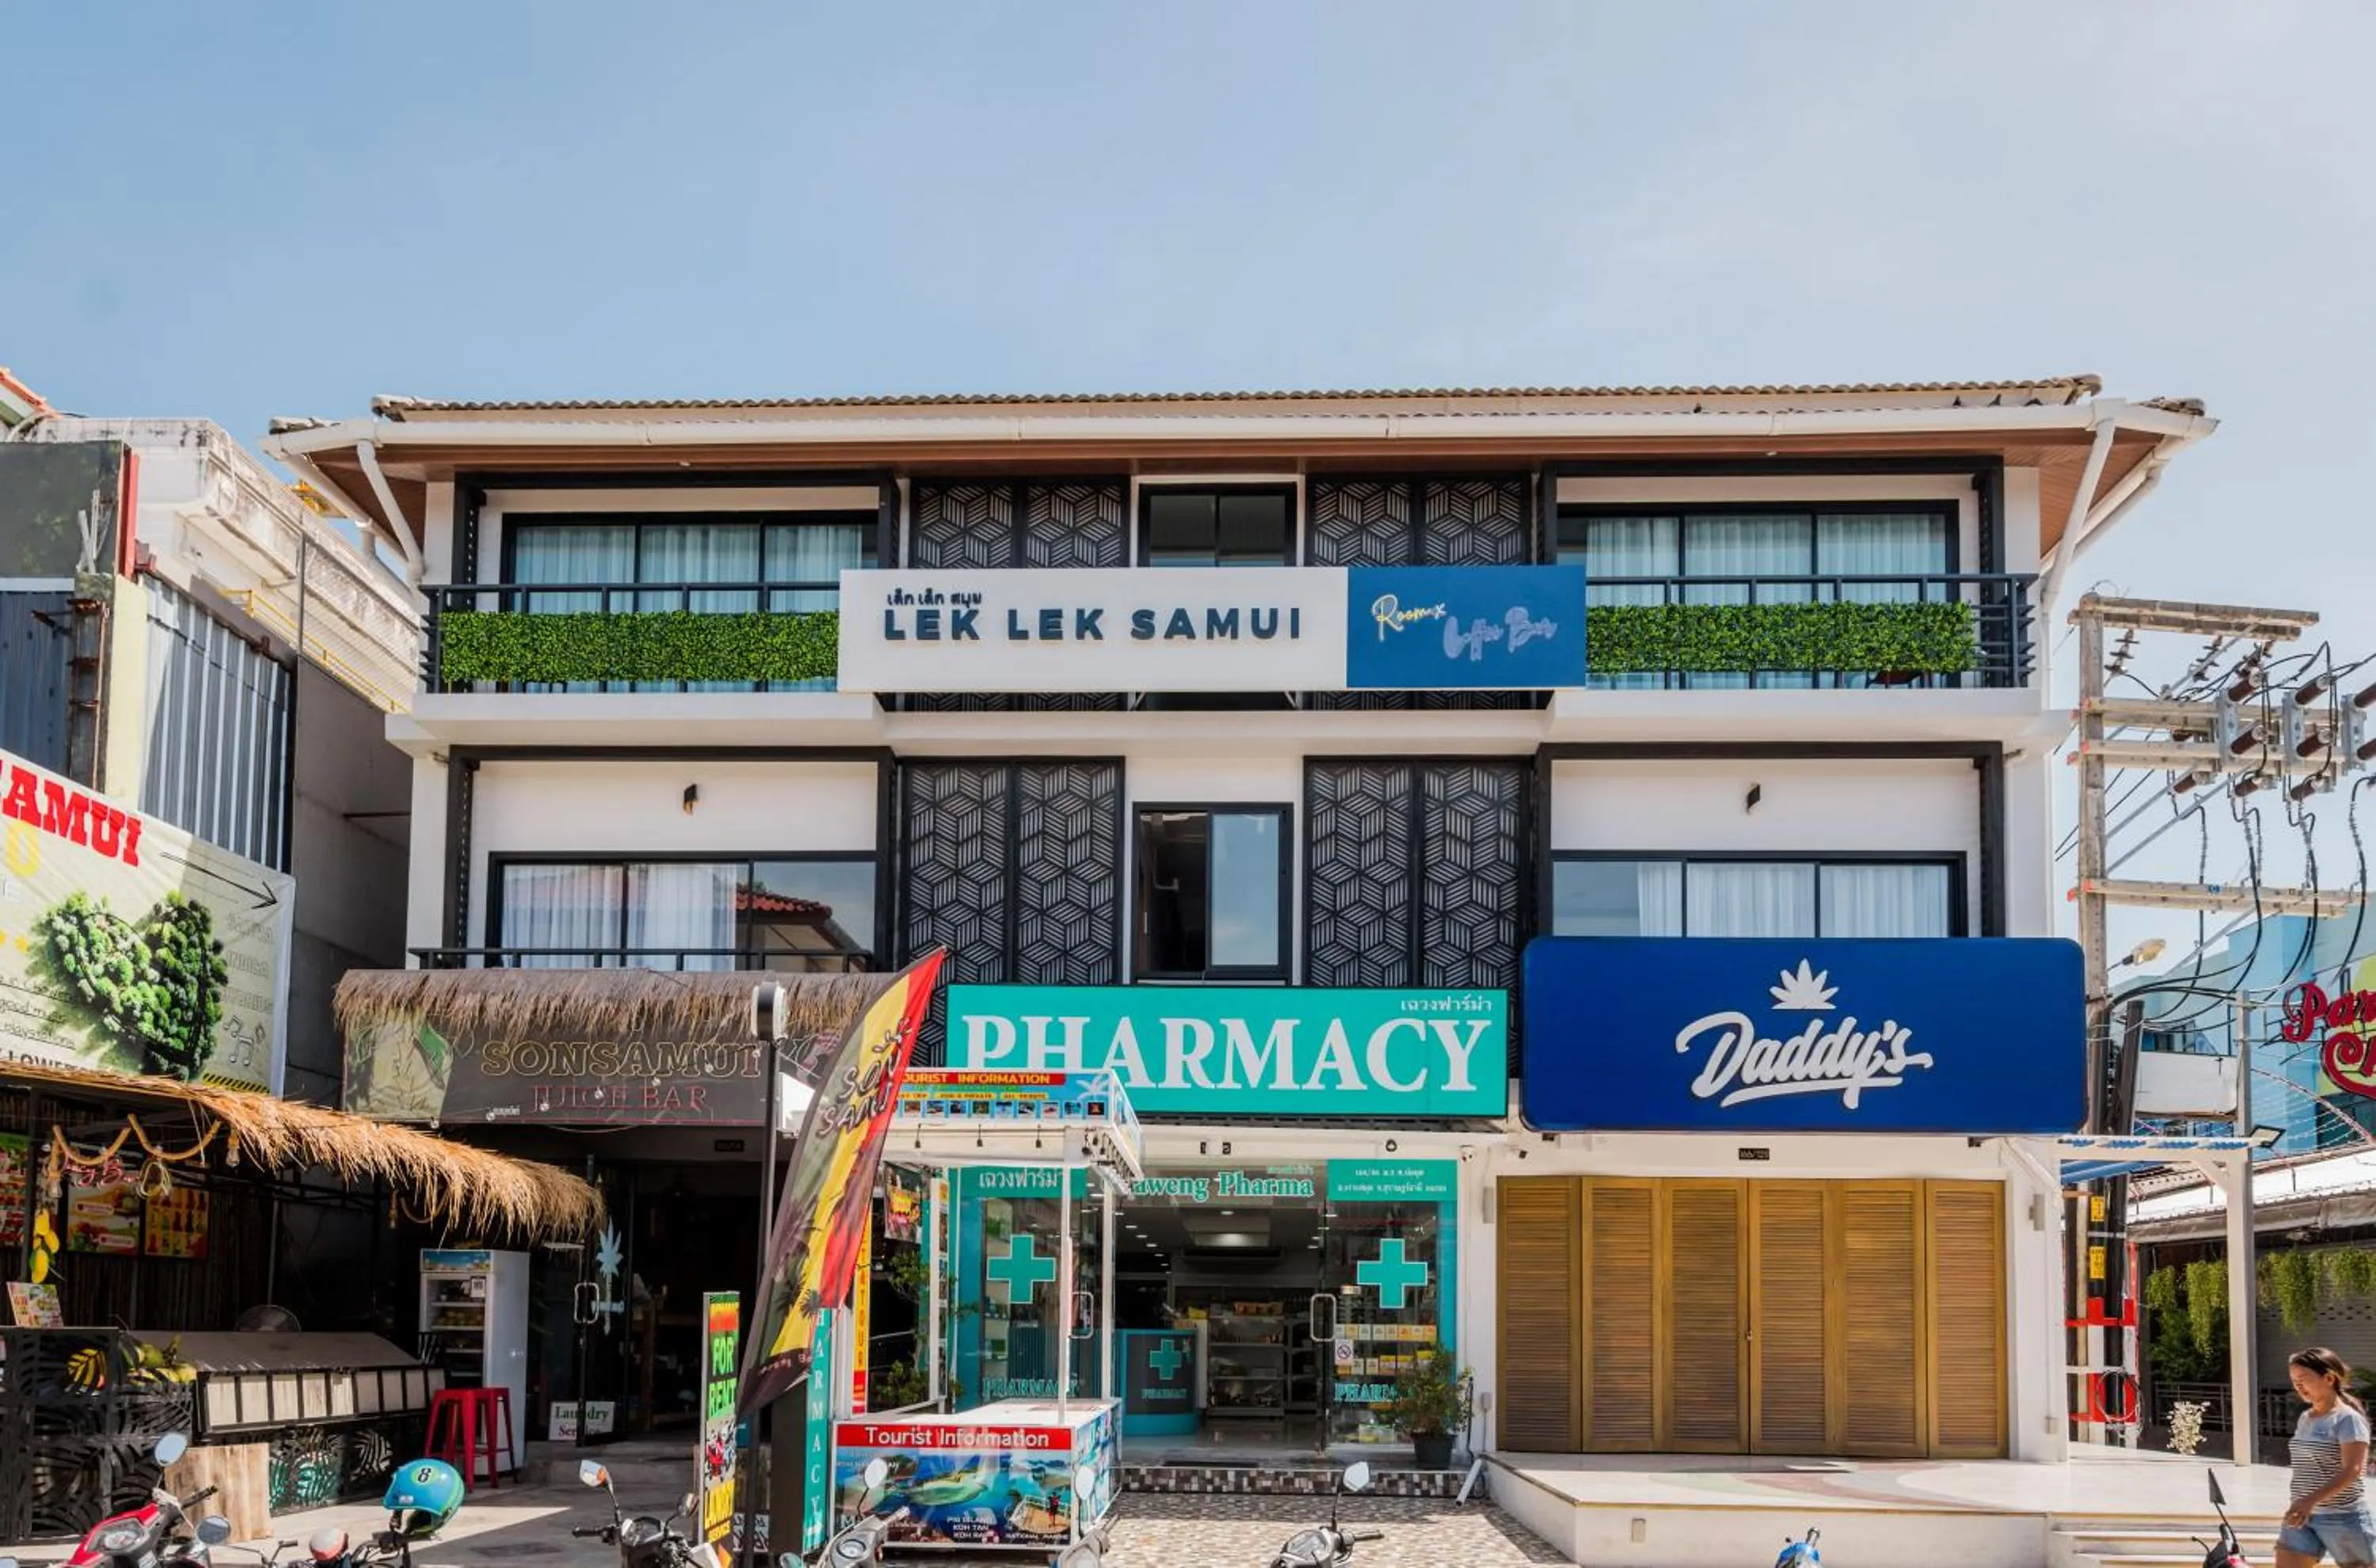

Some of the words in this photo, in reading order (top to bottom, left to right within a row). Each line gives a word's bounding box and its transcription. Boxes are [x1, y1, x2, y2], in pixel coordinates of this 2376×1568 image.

[884, 608, 980, 641] LEK
[1007, 607, 1105, 641] LEK
[1130, 607, 1300, 641] SAMUI
[0, 759, 143, 868] AMUI
[961, 1014, 1492, 1092] PHARMACY
[1674, 1011, 1934, 1109] Daddy's
[904, 1073, 948, 1084] OURIST
[957, 1073, 1050, 1085] INFORMATION
[642, 1086, 709, 1110] BAR
[1133, 1177, 1210, 1203] aweng
[1217, 1170, 1316, 1197] Pharma
[712, 1334, 734, 1375] FOR
[708, 1377, 737, 1418] RENT
[982, 1377, 1078, 1397] PHARMAY
[555, 1406, 608, 1422] Laudry
[810, 1308, 825, 1511] HARMACY
[864, 1426, 932, 1445] Tourist
[940, 1427, 1049, 1448] Information
[417, 1467, 432, 1483] 8
